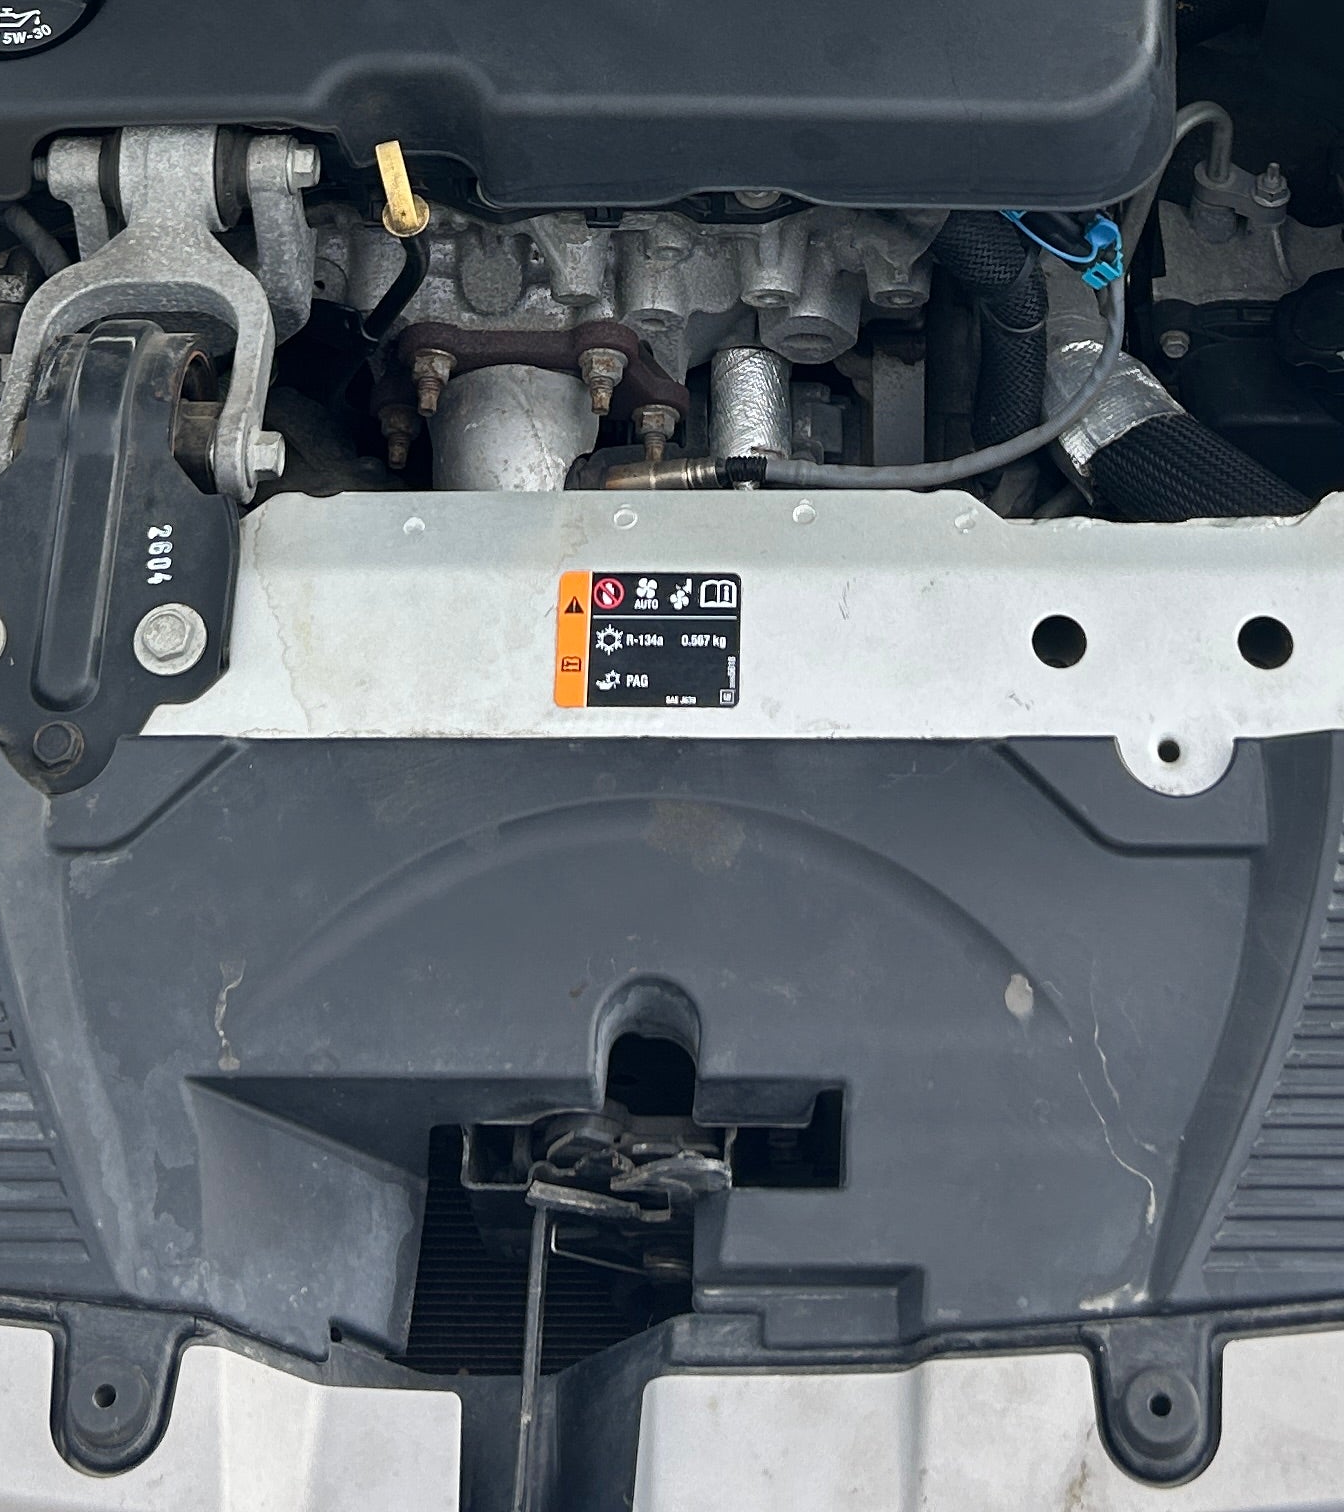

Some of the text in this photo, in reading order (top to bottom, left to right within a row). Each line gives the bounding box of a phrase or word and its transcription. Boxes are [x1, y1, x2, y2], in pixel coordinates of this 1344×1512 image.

[2, 24, 52, 45] 5W-30
[147, 524, 173, 585] 2604
[634, 599, 659, 610] AUTO
[626, 634, 664, 647] R-134a
[712, 634, 727, 649] kg
[626, 674, 649, 688] PAG
[665, 695, 679, 704] SAE
